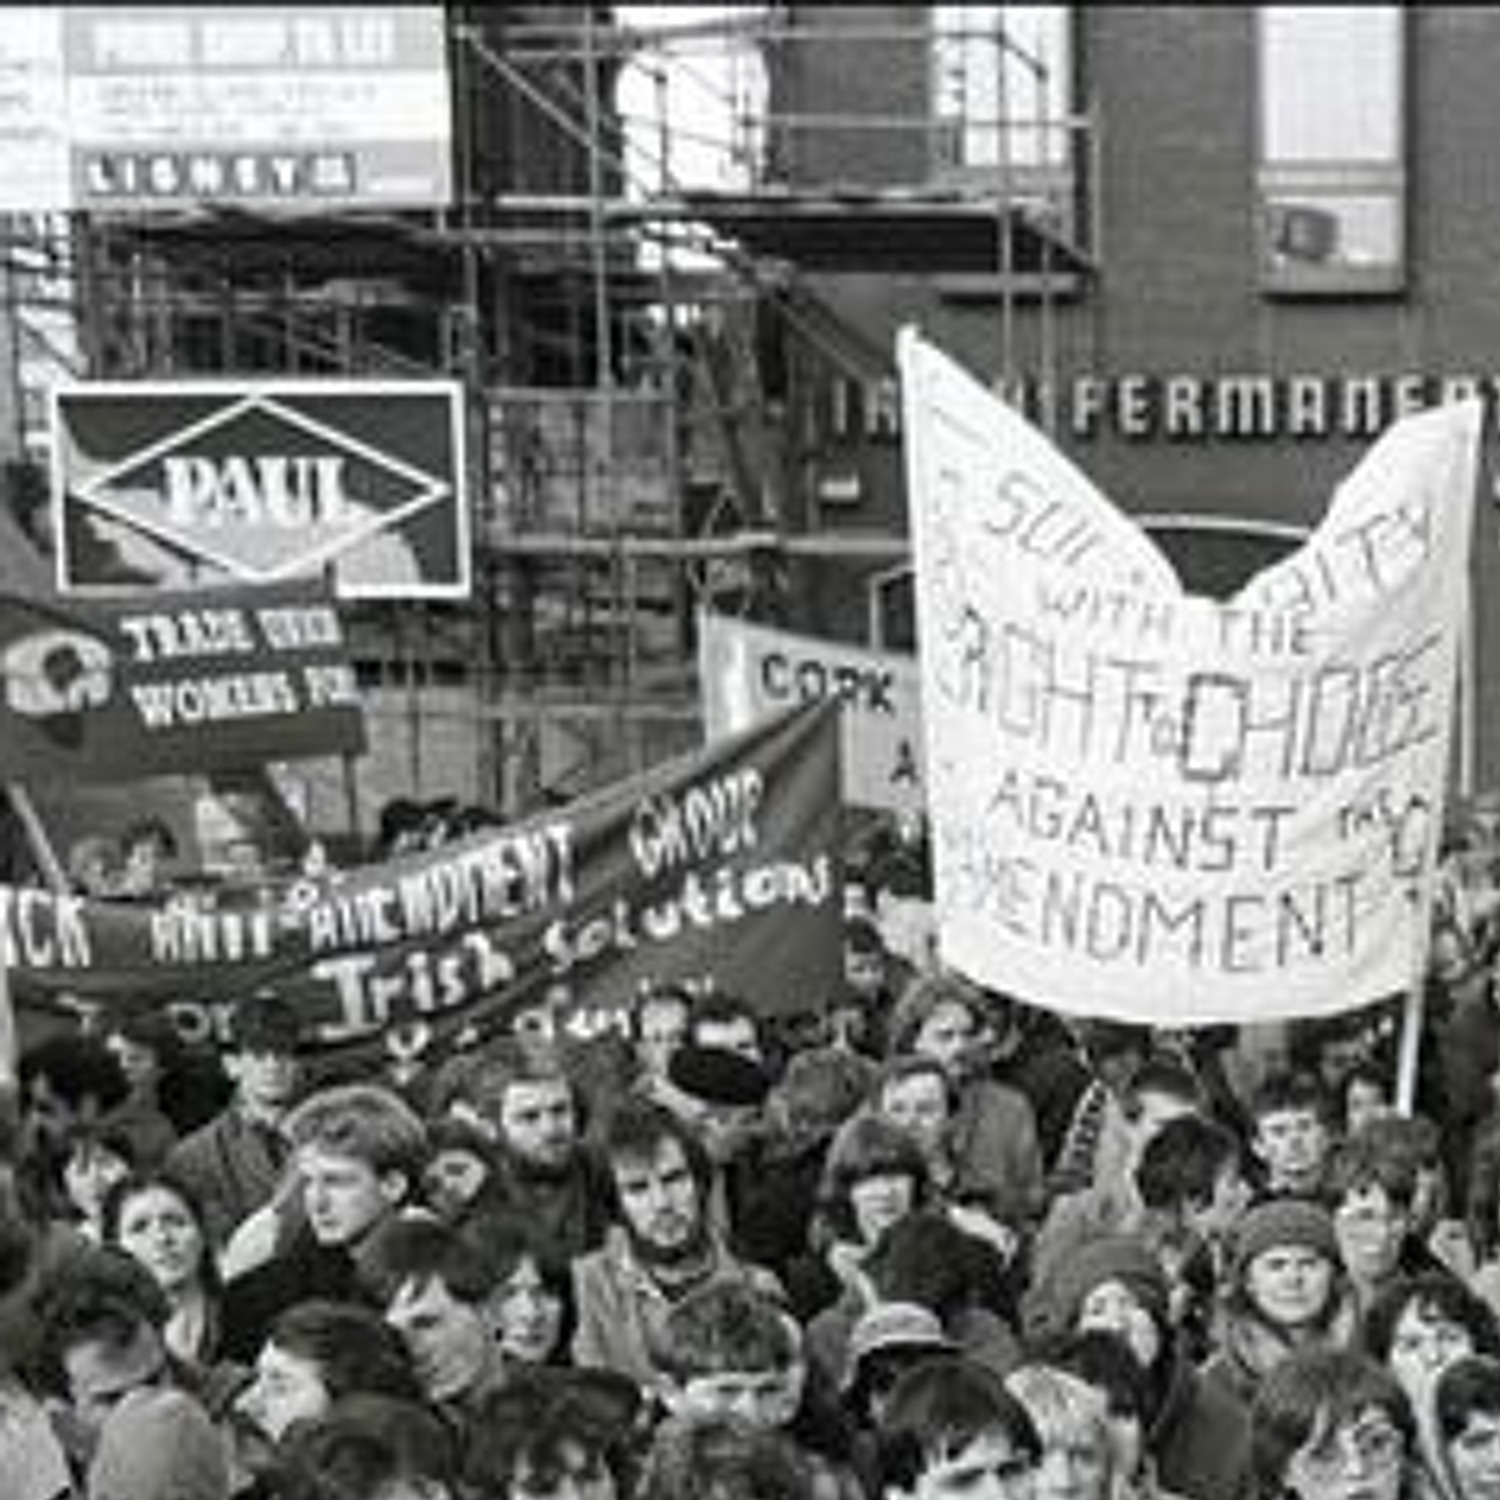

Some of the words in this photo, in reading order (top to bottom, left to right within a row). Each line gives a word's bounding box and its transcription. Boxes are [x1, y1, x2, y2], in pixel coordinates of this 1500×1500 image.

[163, 456, 346, 528] PAUL
[759, 652, 896, 713] CORK
[984, 768, 1299, 875] AGAINST
[950, 847, 1366, 974] ENDMENT
[312, 932, 512, 1040] Irish
